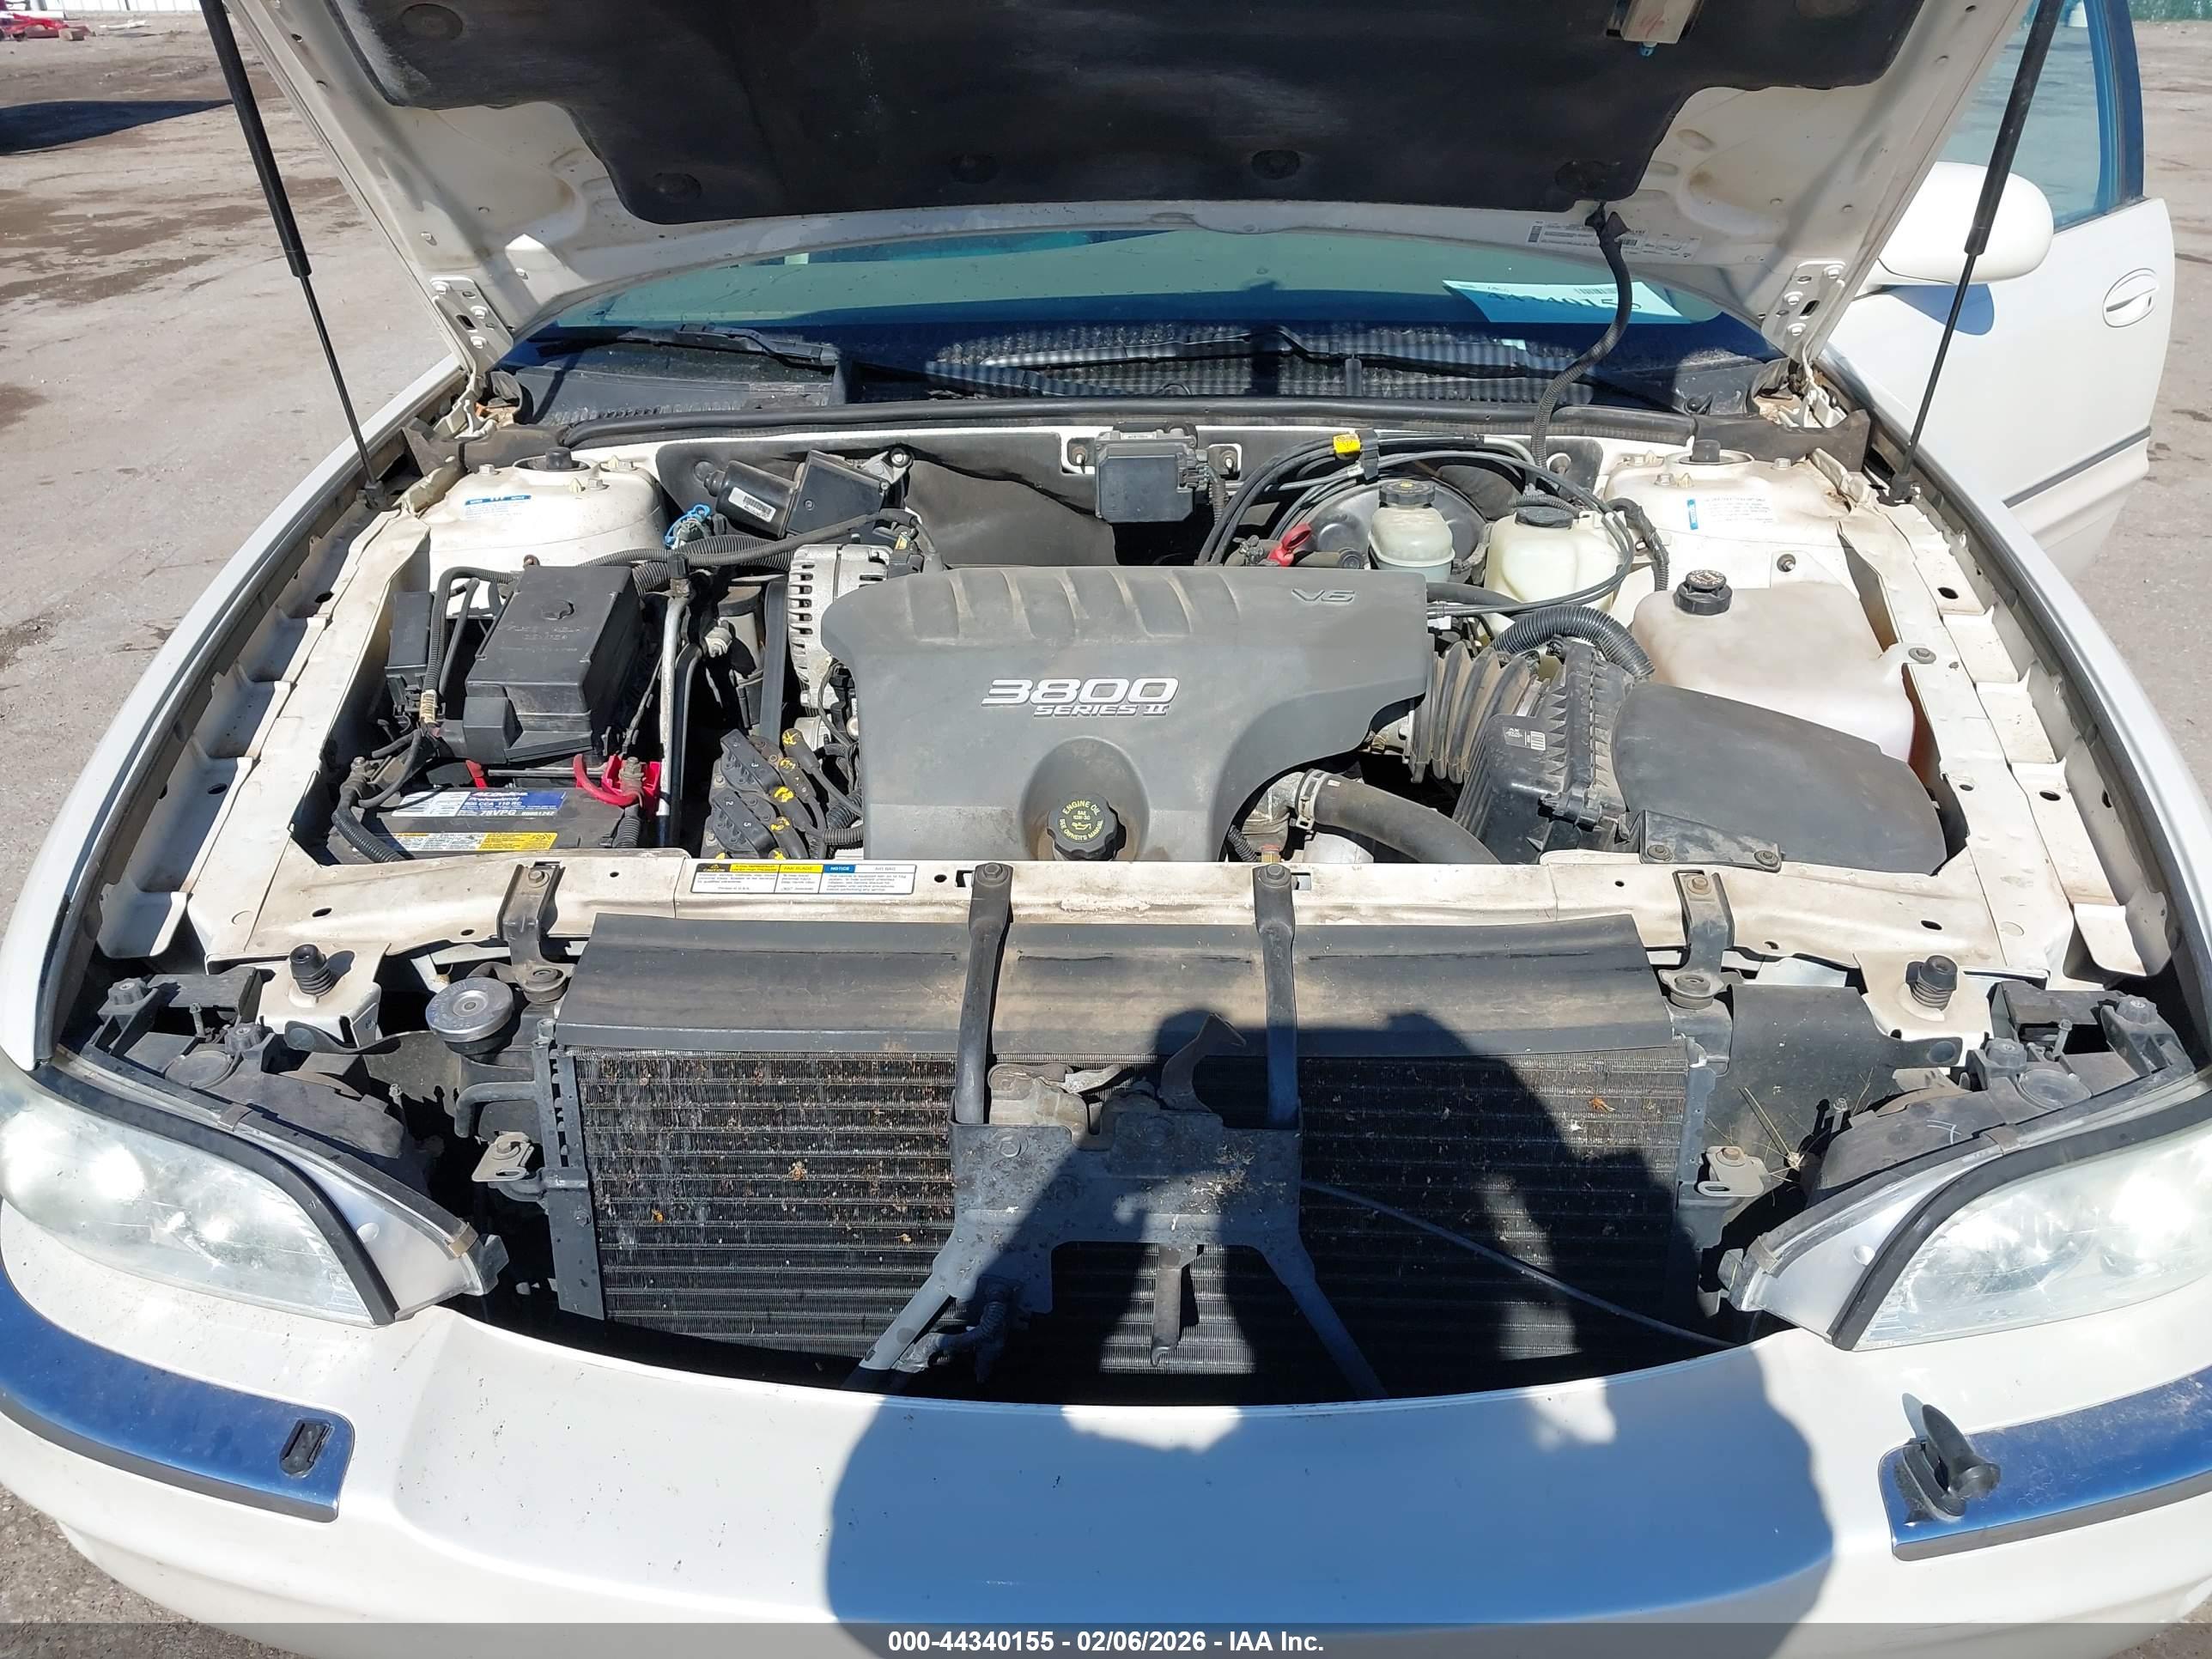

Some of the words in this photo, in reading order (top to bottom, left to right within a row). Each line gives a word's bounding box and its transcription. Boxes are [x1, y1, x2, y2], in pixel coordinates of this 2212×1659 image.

[1291, 589, 1356, 605] V6
[981, 678, 1180, 707] 3800
[1032, 704, 1139, 717] SERIES
[1143, 704, 1170, 716] II
[1062, 800, 1091, 815] ENGINE
[1091, 804, 1101, 816] OIL
[1088, 819, 1103, 839] MANUAL
